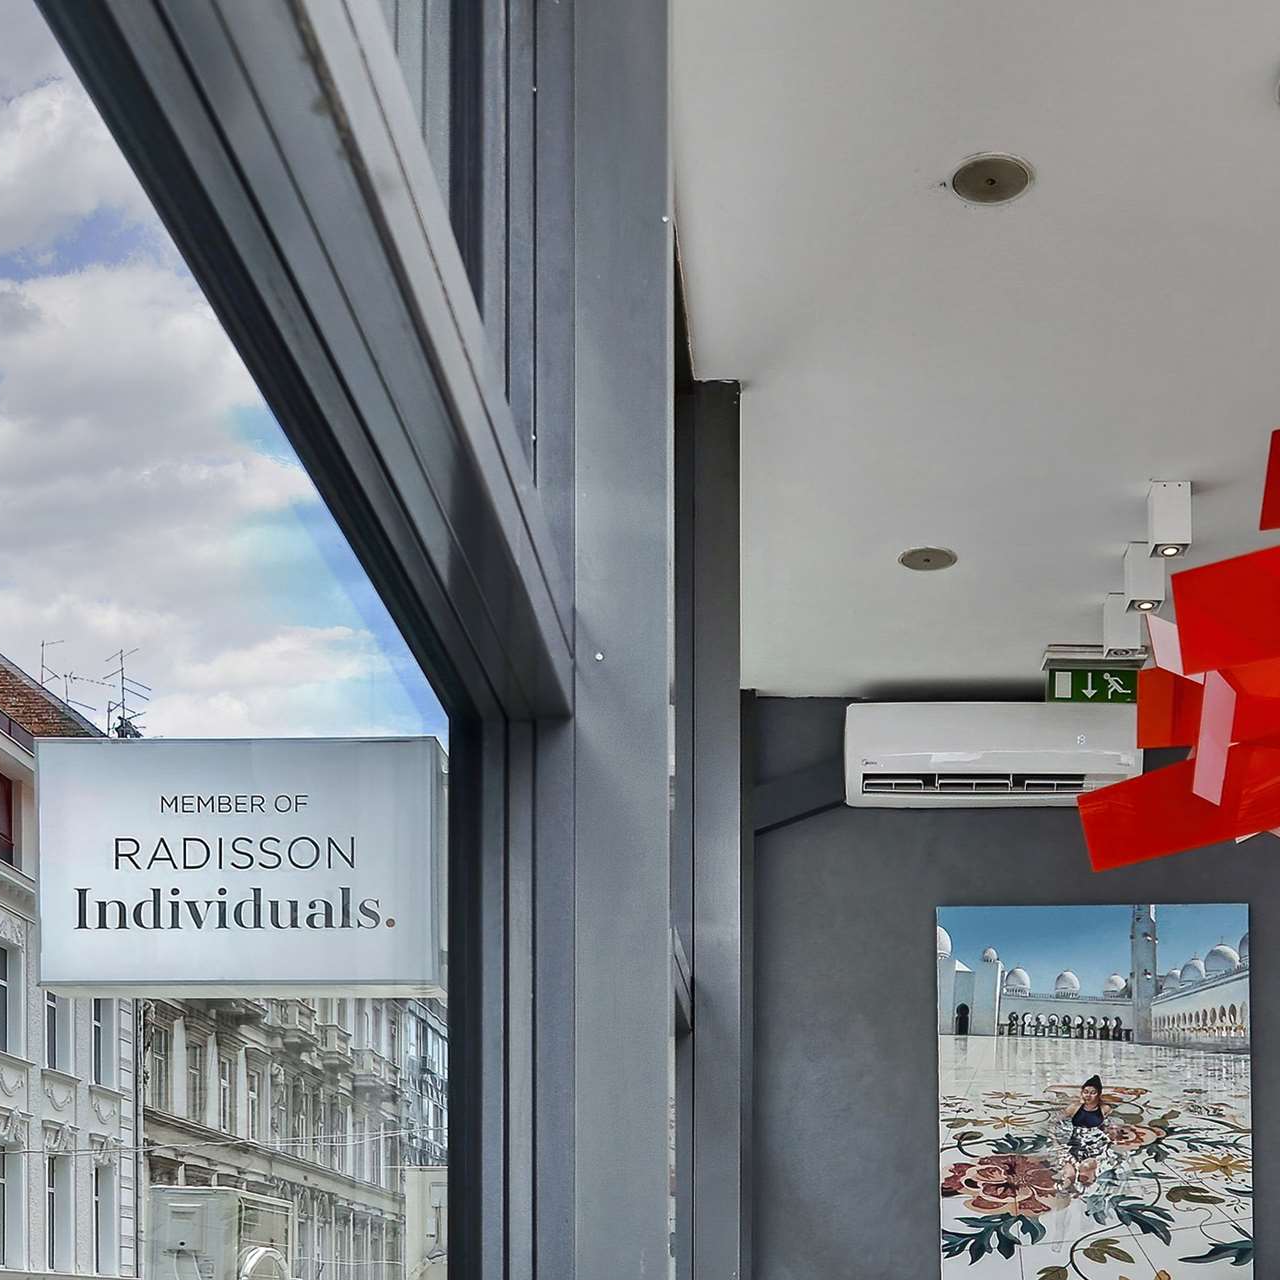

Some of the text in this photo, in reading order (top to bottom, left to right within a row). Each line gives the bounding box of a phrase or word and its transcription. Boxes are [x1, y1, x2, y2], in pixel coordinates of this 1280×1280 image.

[160, 795, 308, 813] MEMBER OF
[114, 836, 356, 870] RADISSON
[73, 887, 396, 930] Individuals.
